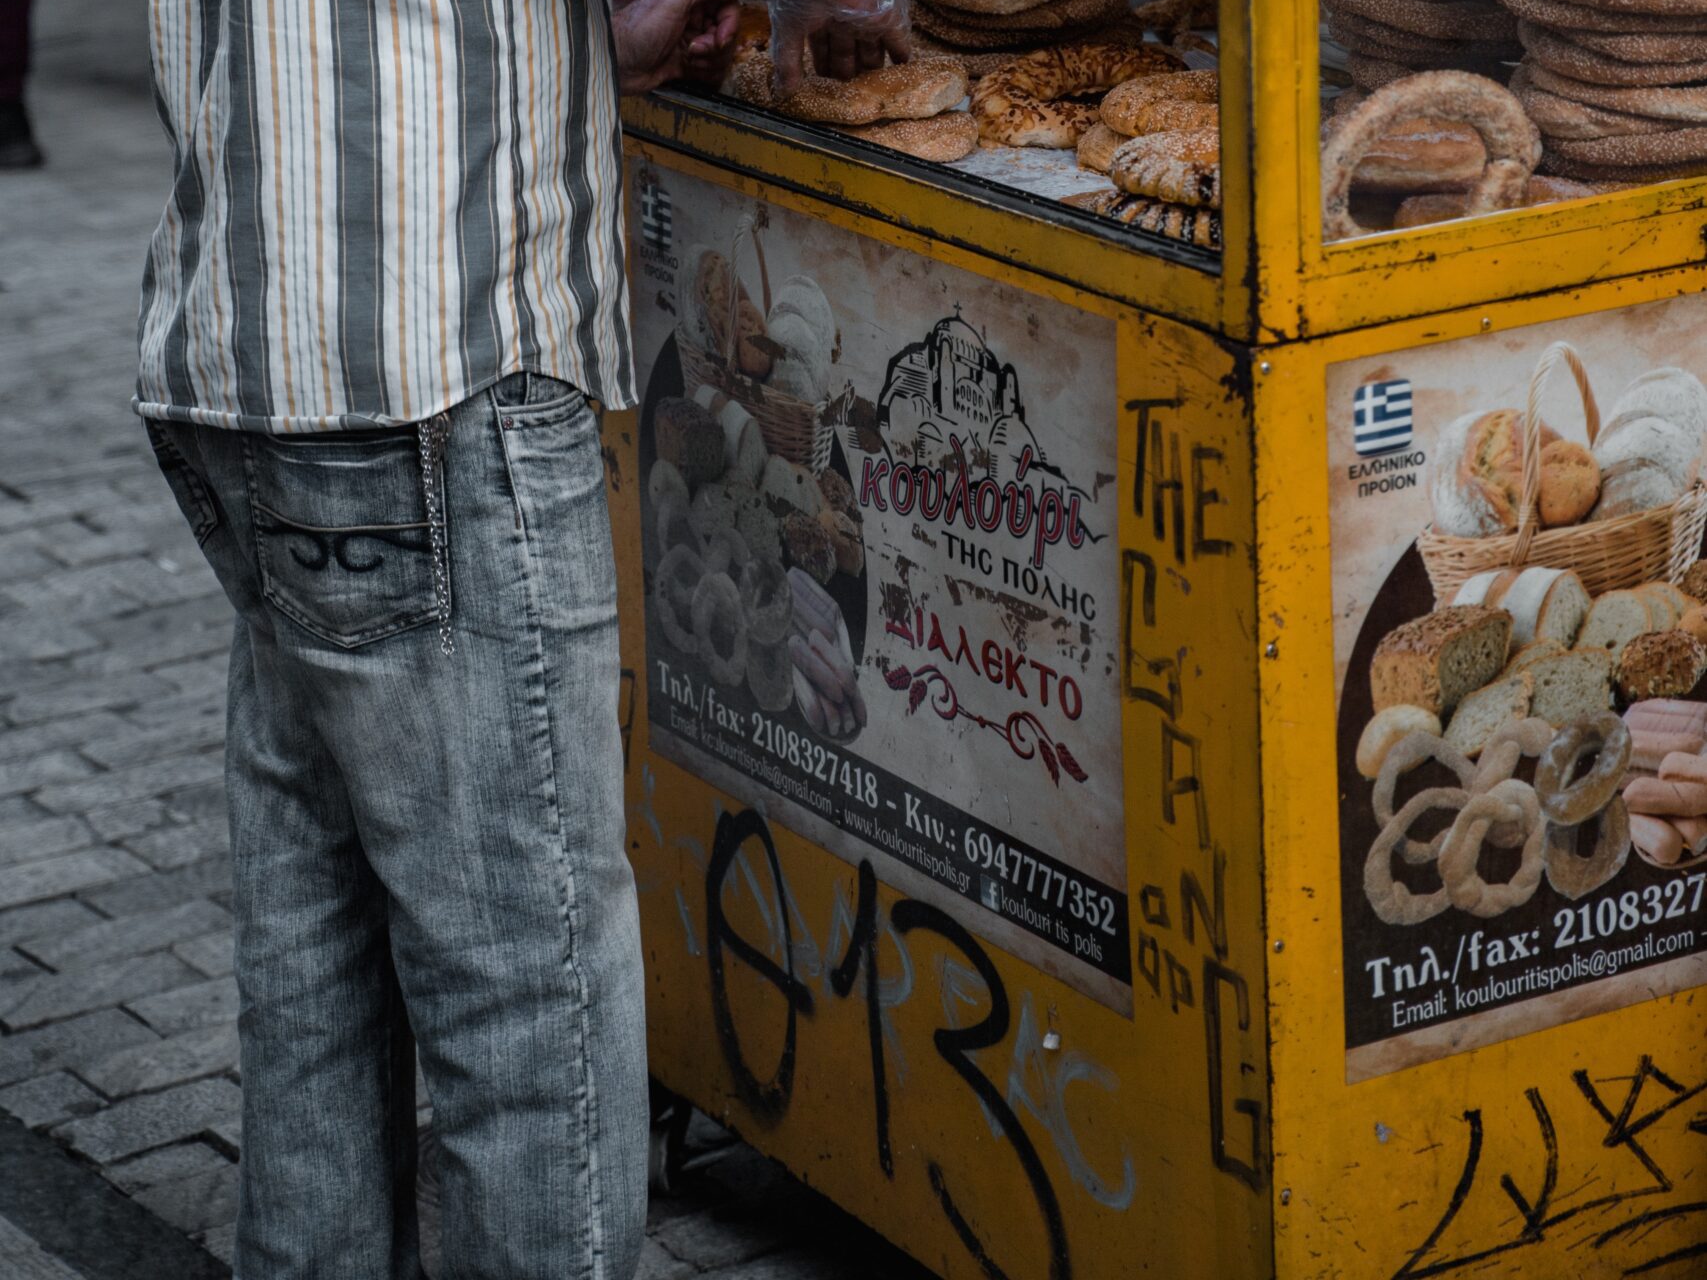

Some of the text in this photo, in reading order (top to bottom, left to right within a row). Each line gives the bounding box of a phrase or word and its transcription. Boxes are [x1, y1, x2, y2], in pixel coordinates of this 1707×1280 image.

[1348, 451, 1426, 480] ΕΛΛΗΝΙΚΟ
[752, 712, 879, 809] 2108327418
[964, 826, 1117, 937] 6947777352
[844, 805, 971, 894] www.koulouritispolis.gr
[1001, 886, 1051, 934] koulouri
[1055, 920, 1070, 945] tis
[1075, 932, 1104, 963] polis
[1392, 930, 1695, 1029] Email: koulouritispolis@gmail.com
